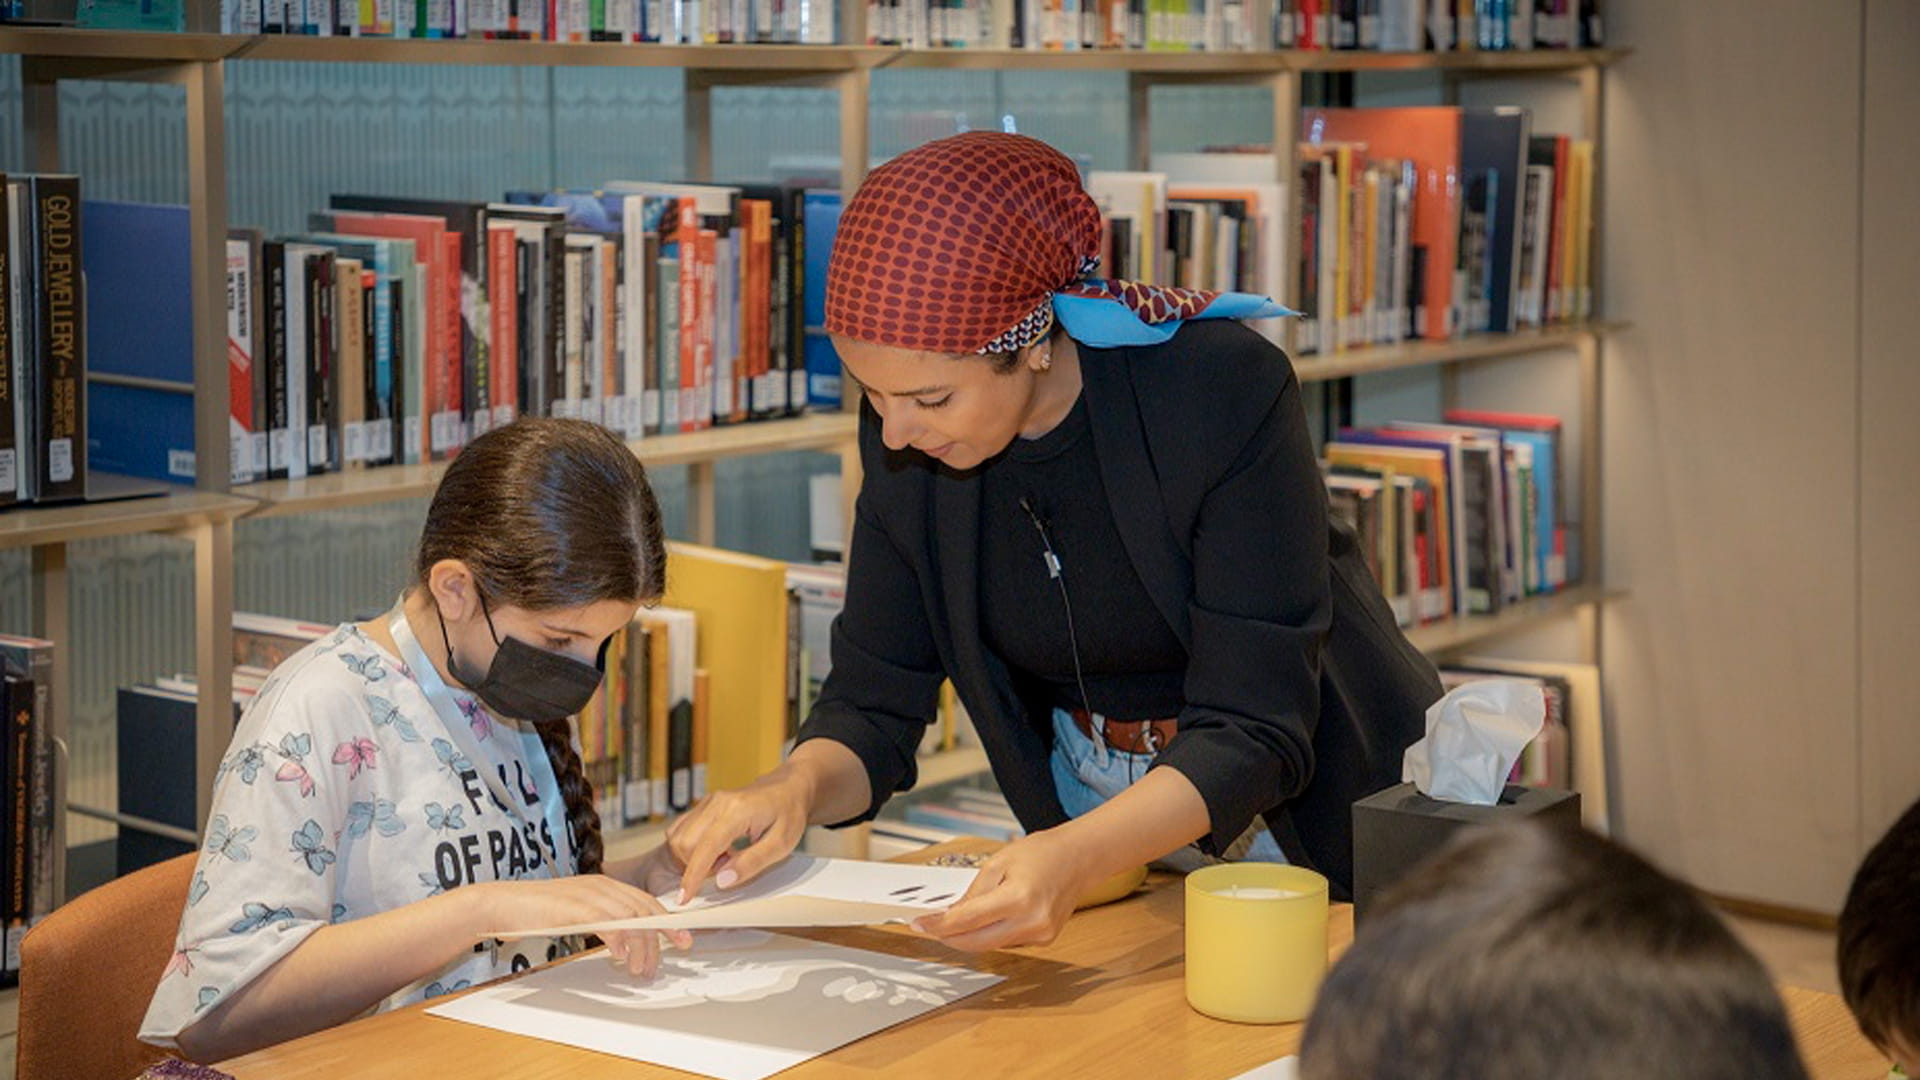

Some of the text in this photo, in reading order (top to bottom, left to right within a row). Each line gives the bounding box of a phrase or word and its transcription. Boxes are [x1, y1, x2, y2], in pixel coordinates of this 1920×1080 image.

[47, 195, 75, 360] GOLD JEWELLERY
[34, 685, 48, 755] Diamond
[31, 759, 47, 817] Jewelry
[435, 834, 482, 891] OF
